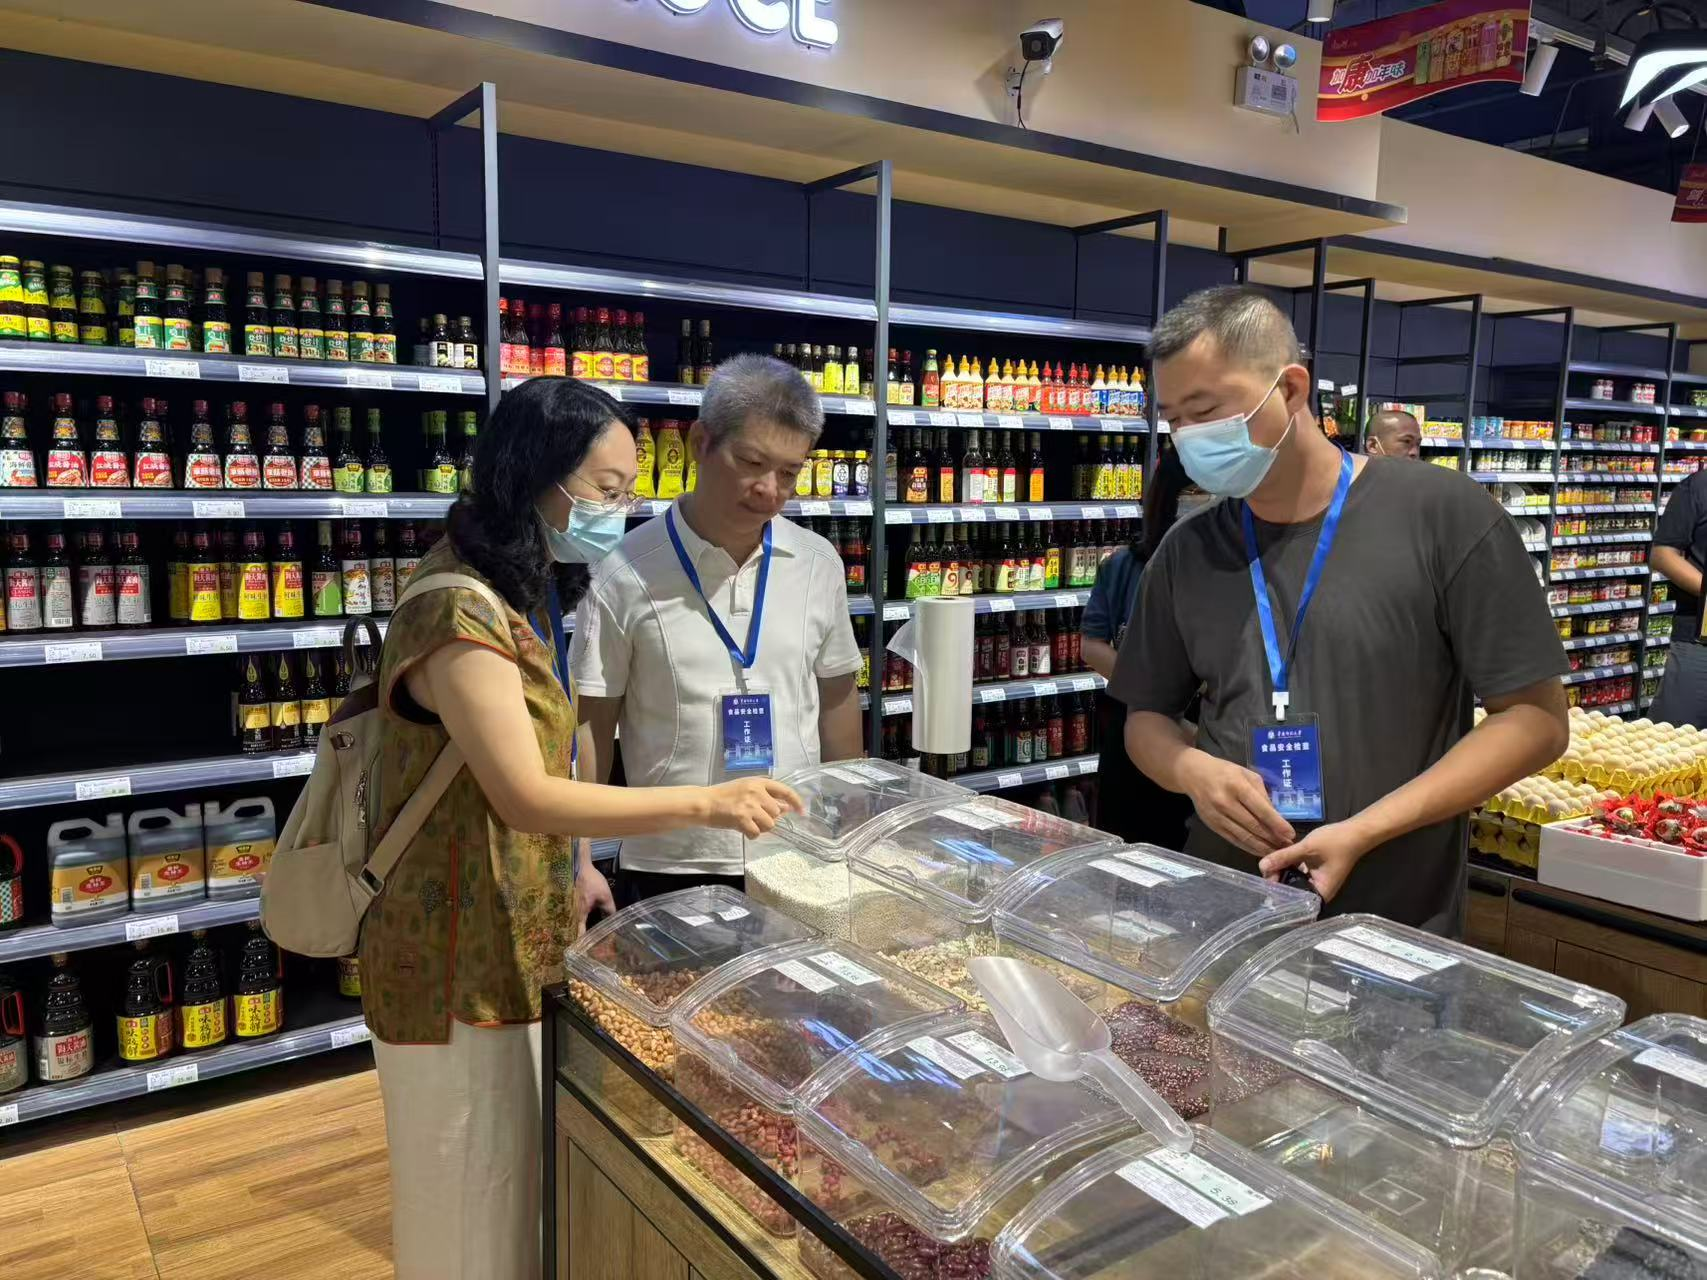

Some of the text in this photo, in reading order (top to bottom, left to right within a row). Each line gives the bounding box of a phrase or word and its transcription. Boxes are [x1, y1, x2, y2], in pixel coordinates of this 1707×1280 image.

[743, 720, 752, 743] 工作证
[1261, 742, 1310, 753] 食品安全检查
[1281, 759, 1293, 788] 工作证
